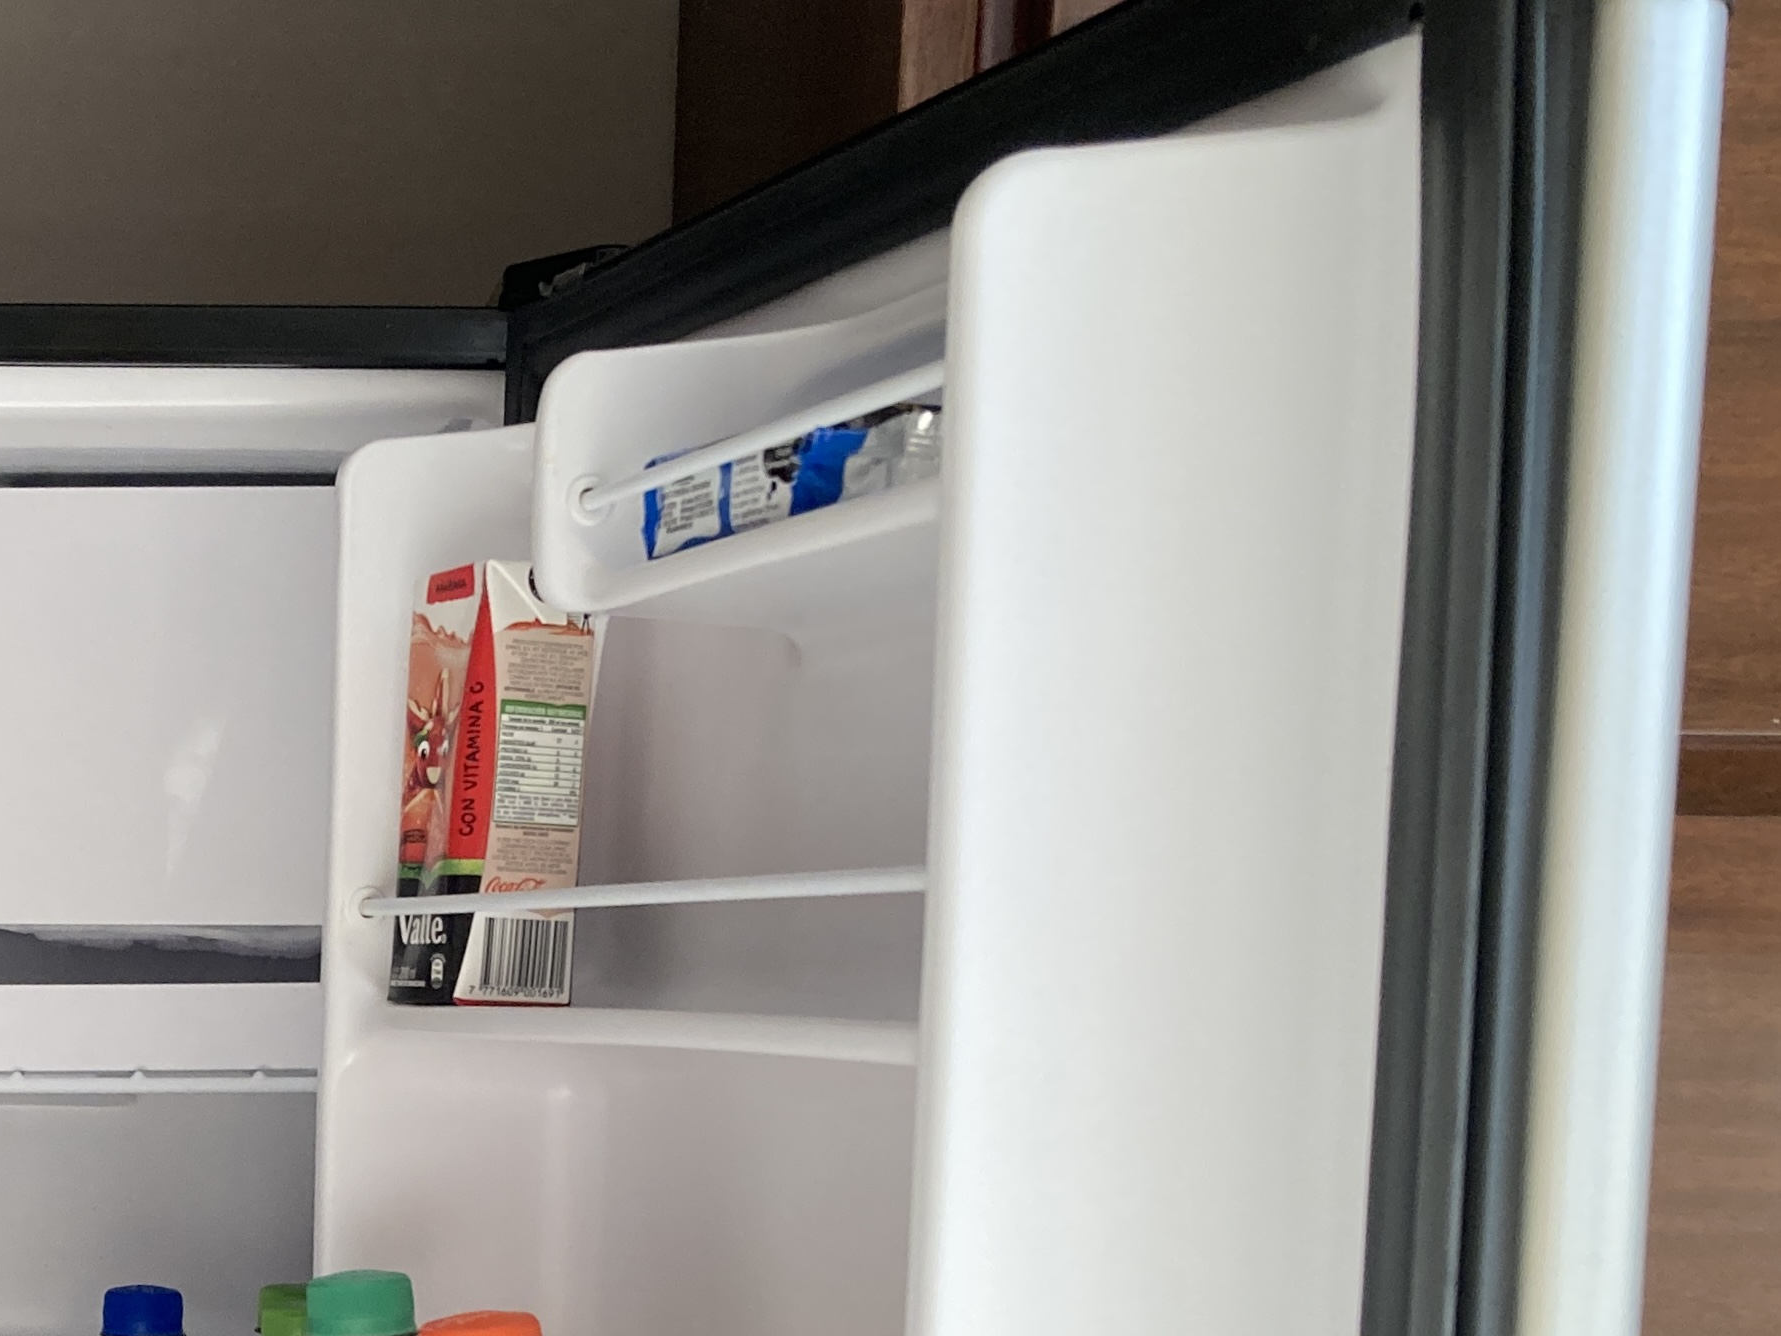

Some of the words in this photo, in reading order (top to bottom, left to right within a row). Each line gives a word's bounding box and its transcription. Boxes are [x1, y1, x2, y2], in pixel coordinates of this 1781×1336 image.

[469, 681, 485, 693] C
[463, 696, 484, 783] VITAMINA
[458, 788, 475, 837] CON
[398, 914, 444, 945] Valle
